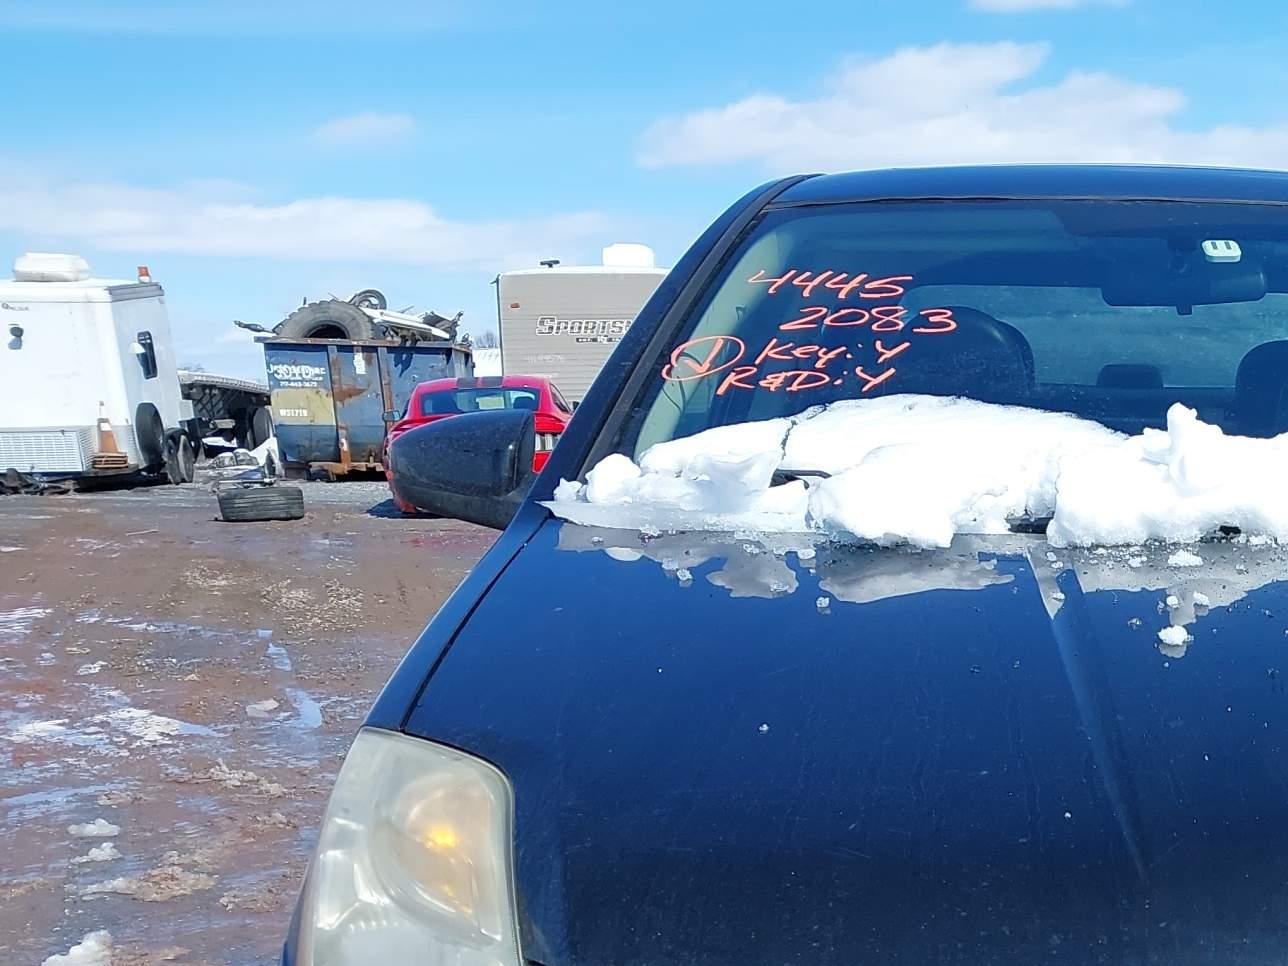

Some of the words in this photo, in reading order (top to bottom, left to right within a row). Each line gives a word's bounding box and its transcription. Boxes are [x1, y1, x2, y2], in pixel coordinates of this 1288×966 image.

[748, 269, 914, 299] 4445
[779, 306, 957, 333] 2083
[875, 340, 911, 363] Y
[855, 366, 896, 392] Y
